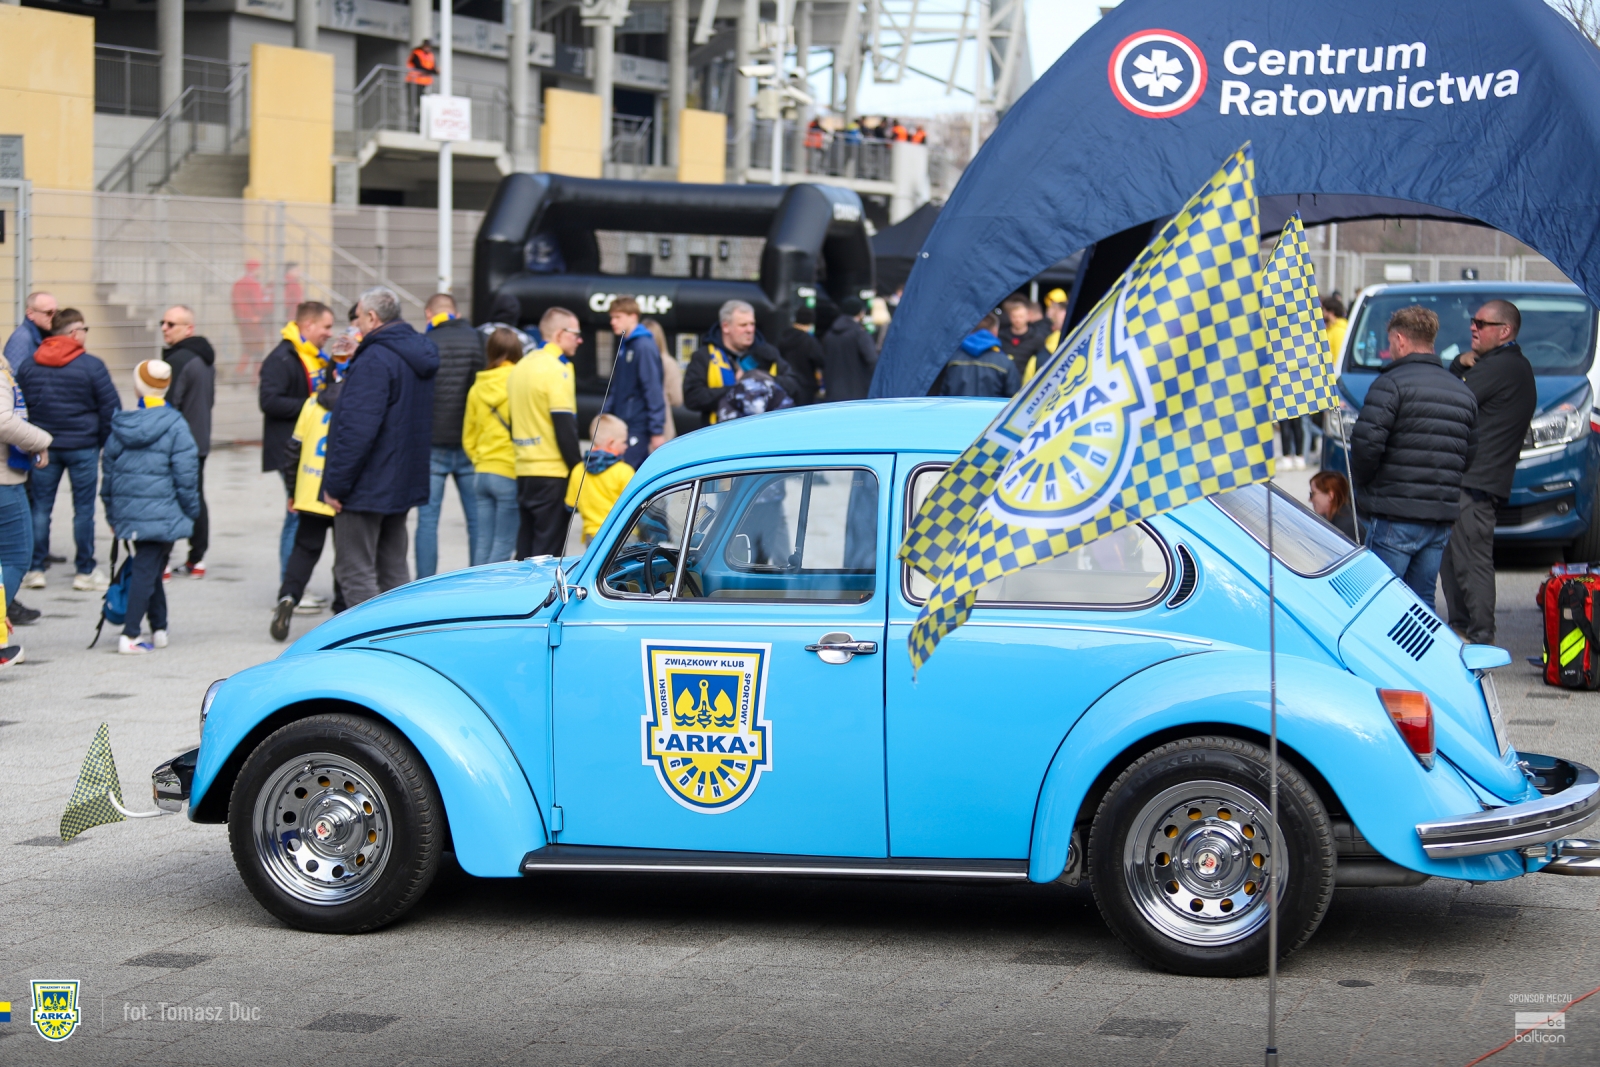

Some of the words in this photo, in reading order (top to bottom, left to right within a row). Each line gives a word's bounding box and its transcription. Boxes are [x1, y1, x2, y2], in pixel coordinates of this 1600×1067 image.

[1222, 39, 1427, 76] Centrum
[1219, 68, 1520, 117] Ratownictwa
[664, 658, 718, 668] ZWIĄZKOWY
[720, 660, 745, 668] KLUB
[659, 678, 668, 716] MORSKI
[740, 672, 752, 726] SPORTOWY
[665, 733, 748, 754] ARKA
[669, 758, 747, 798] GDYNIA
[1132, 754, 1206, 785] NEXEN
